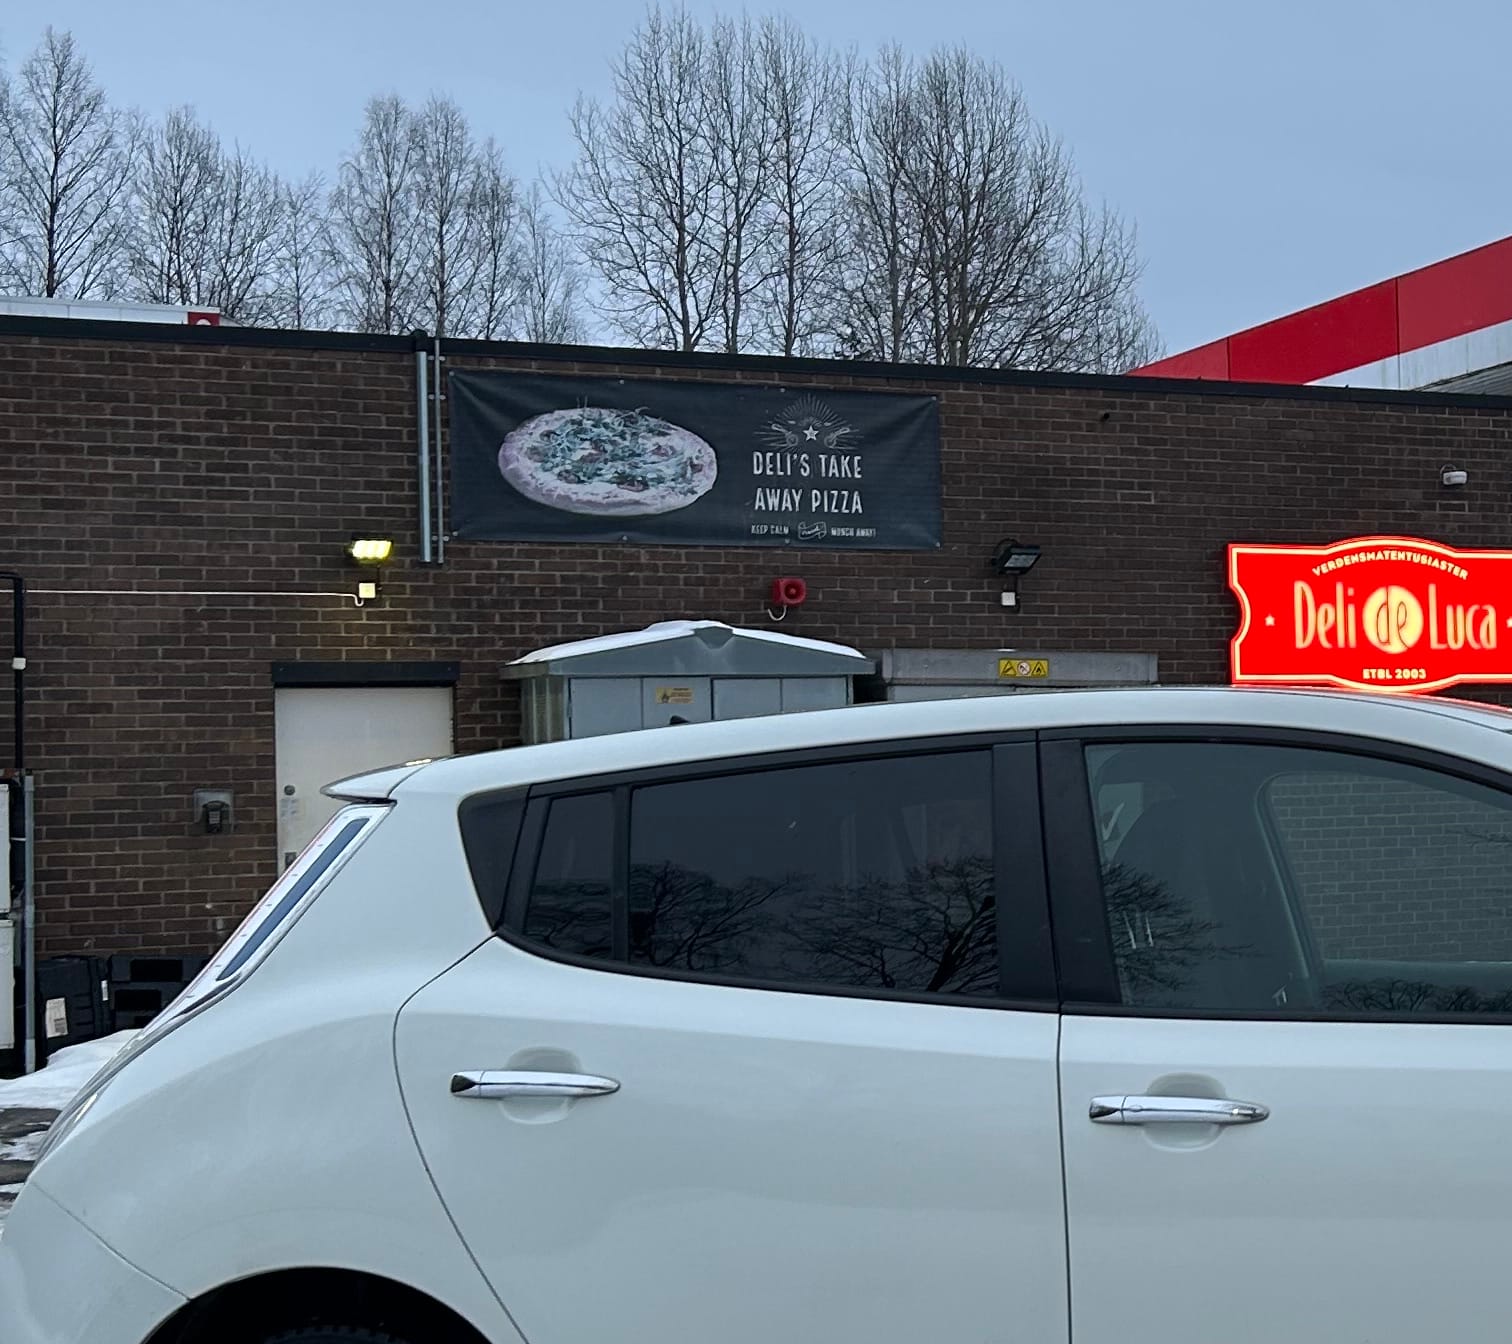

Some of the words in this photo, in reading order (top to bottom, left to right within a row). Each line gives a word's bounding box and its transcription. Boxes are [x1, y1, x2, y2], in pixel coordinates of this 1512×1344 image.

[753, 452, 810, 476] DELI'S
[819, 455, 862, 478] TAKE
[755, 488, 802, 511] AWAY
[812, 490, 862, 513] PIZZA
[1312, 550, 1468, 580] VERDENSMATENTUSIASTER
[1294, 580, 1357, 649] Deli
[1428, 584, 1497, 650] Luca
[1395, 668, 1426, 679] 2003
